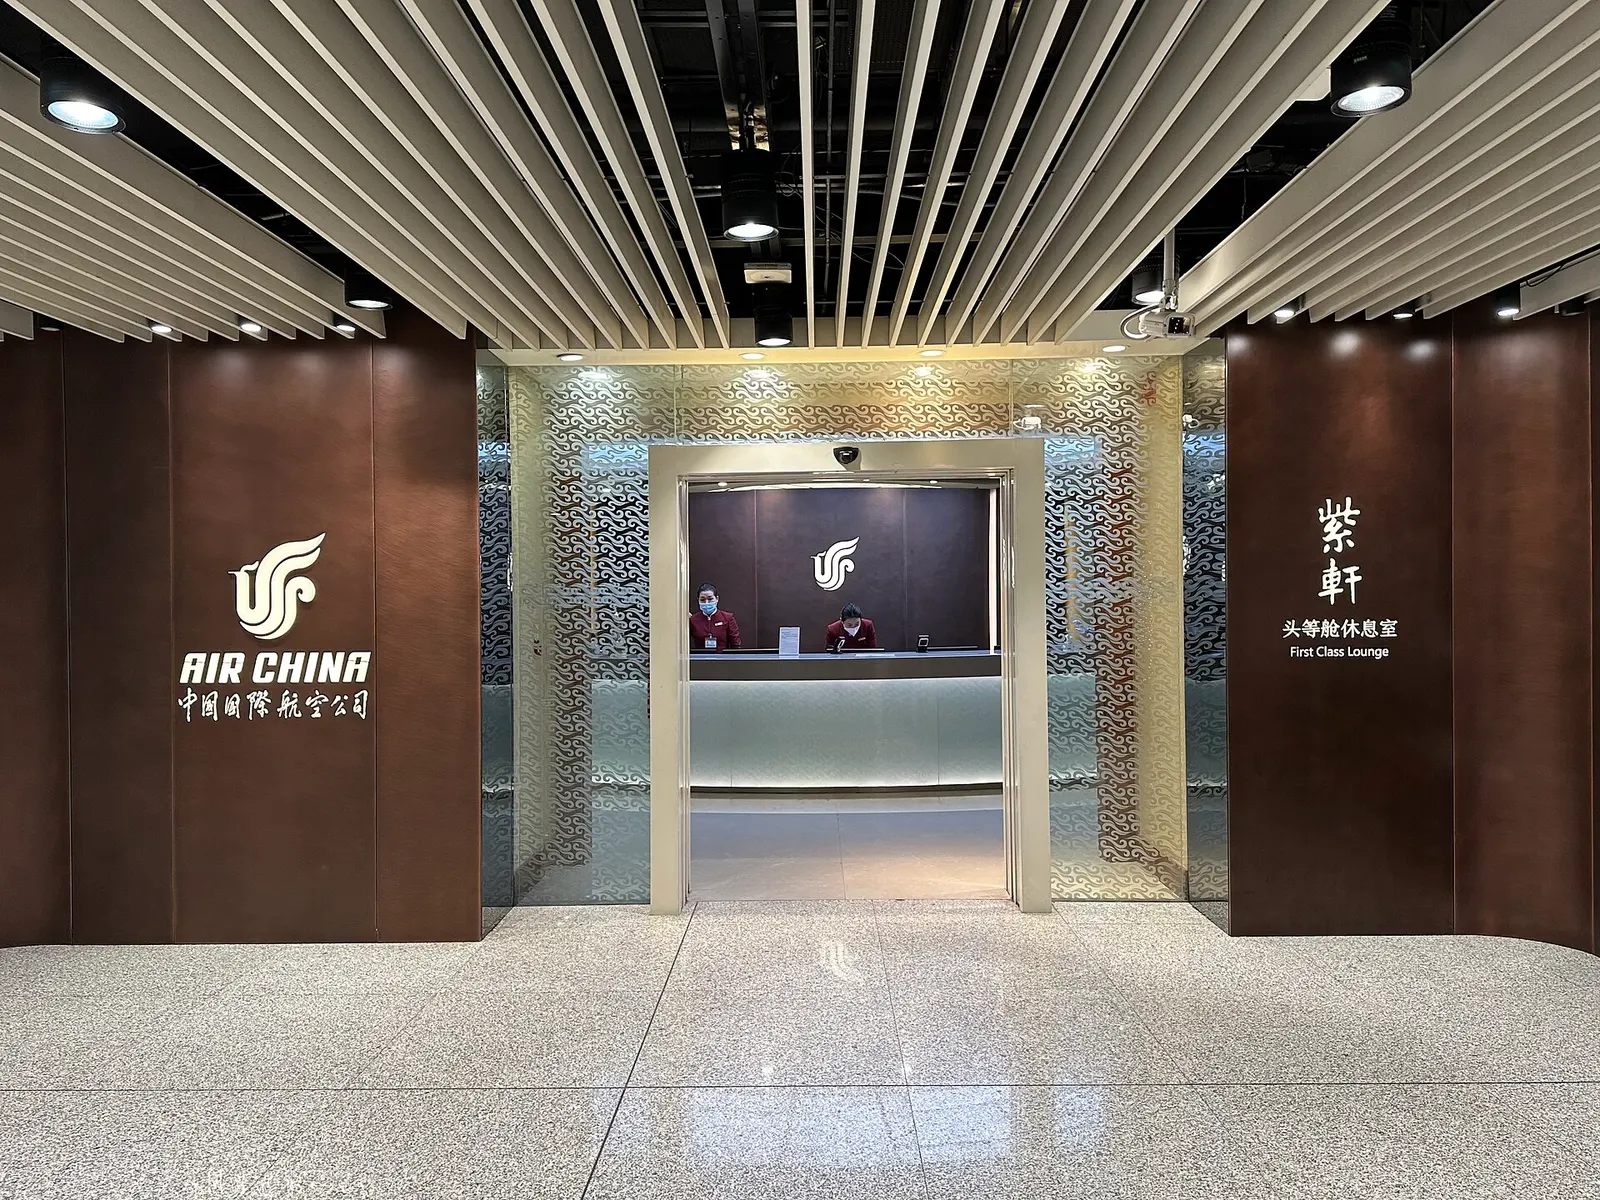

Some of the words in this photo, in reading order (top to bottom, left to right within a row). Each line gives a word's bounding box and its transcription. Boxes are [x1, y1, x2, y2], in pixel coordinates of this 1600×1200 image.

[1282, 619, 1399, 640] 头等舱休息室
[1290, 646, 1314, 658] First
[1316, 646, 1345, 658] Class
[1347, 646, 1390, 660] Lounge
[179, 652, 246, 684] AIR
[252, 651, 372, 684] CHINA
